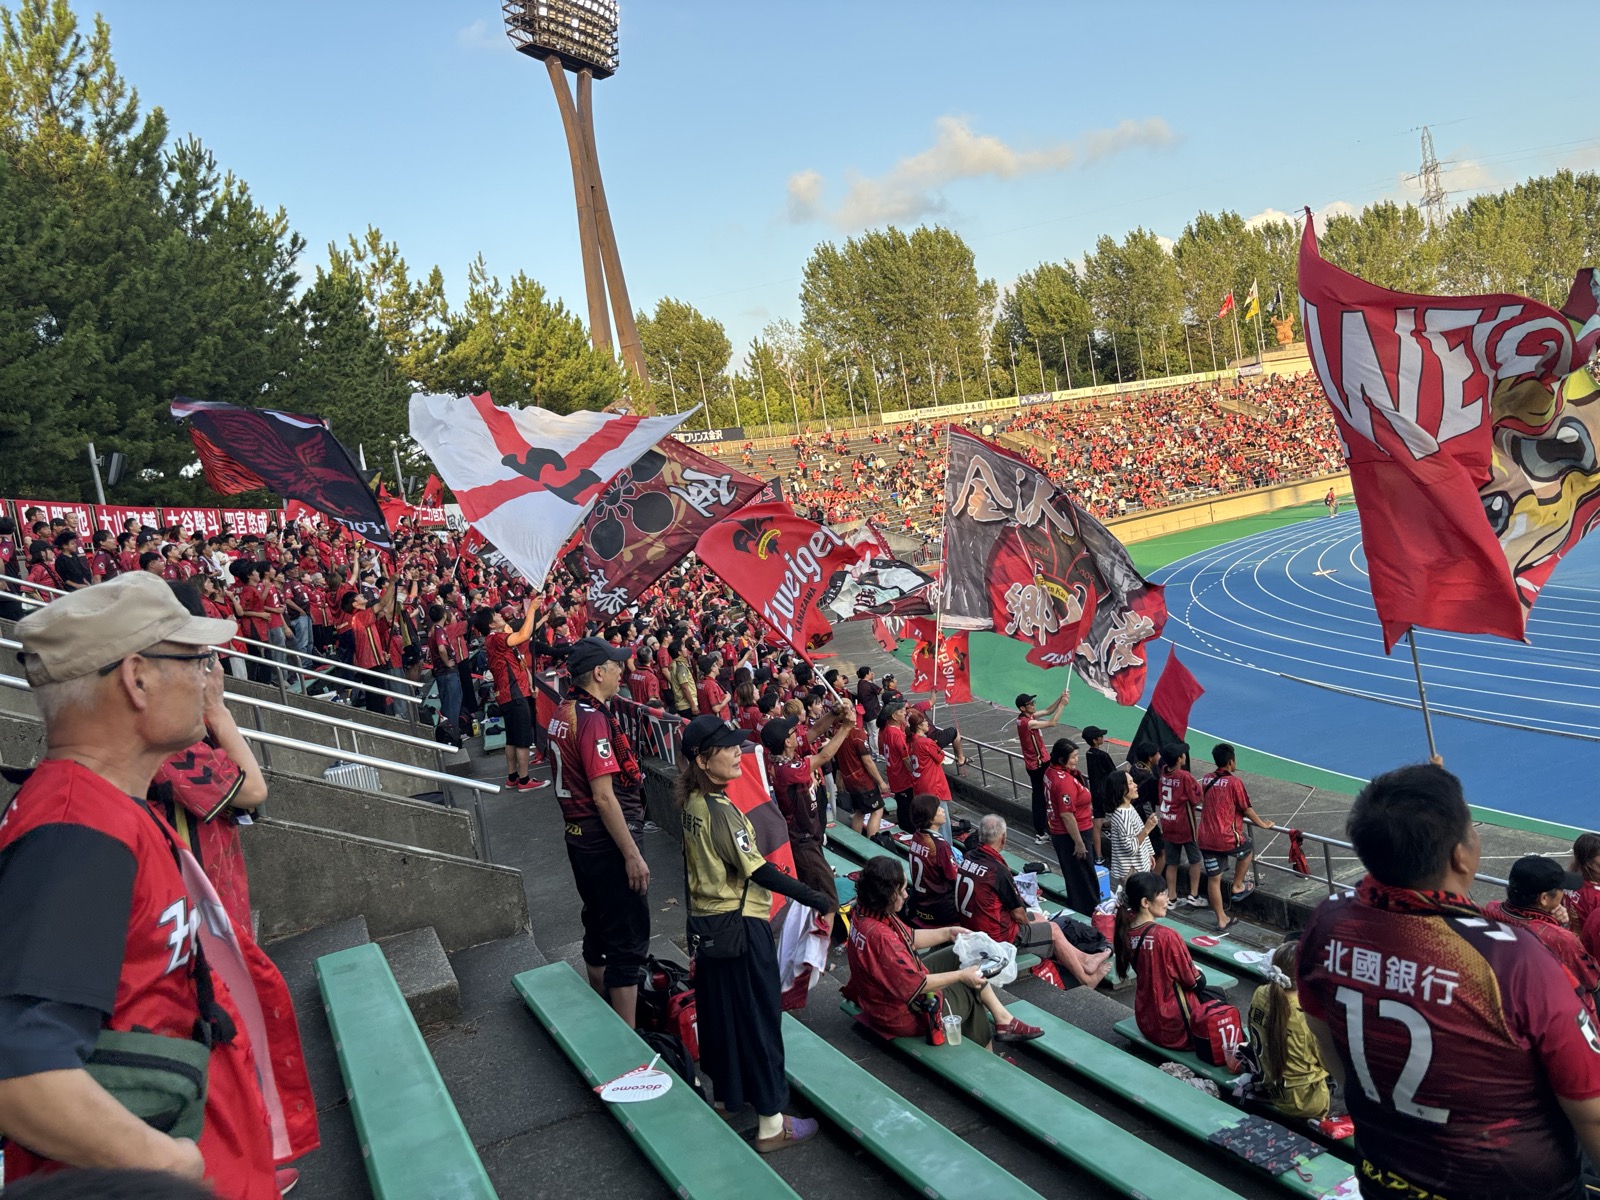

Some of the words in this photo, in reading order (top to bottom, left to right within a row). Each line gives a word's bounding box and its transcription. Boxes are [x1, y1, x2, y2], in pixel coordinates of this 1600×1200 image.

[224, 511, 268, 535] 四宮悠成
[793, 586, 818, 633] KANAZAWA
[954, 872, 974, 919] 12
[1323, 938, 1460, 1006] 北國銀行
[1218, 1023, 1236, 1051] 12
[1335, 985, 1451, 1124] 12
[611, 1083, 662, 1092] docomo
